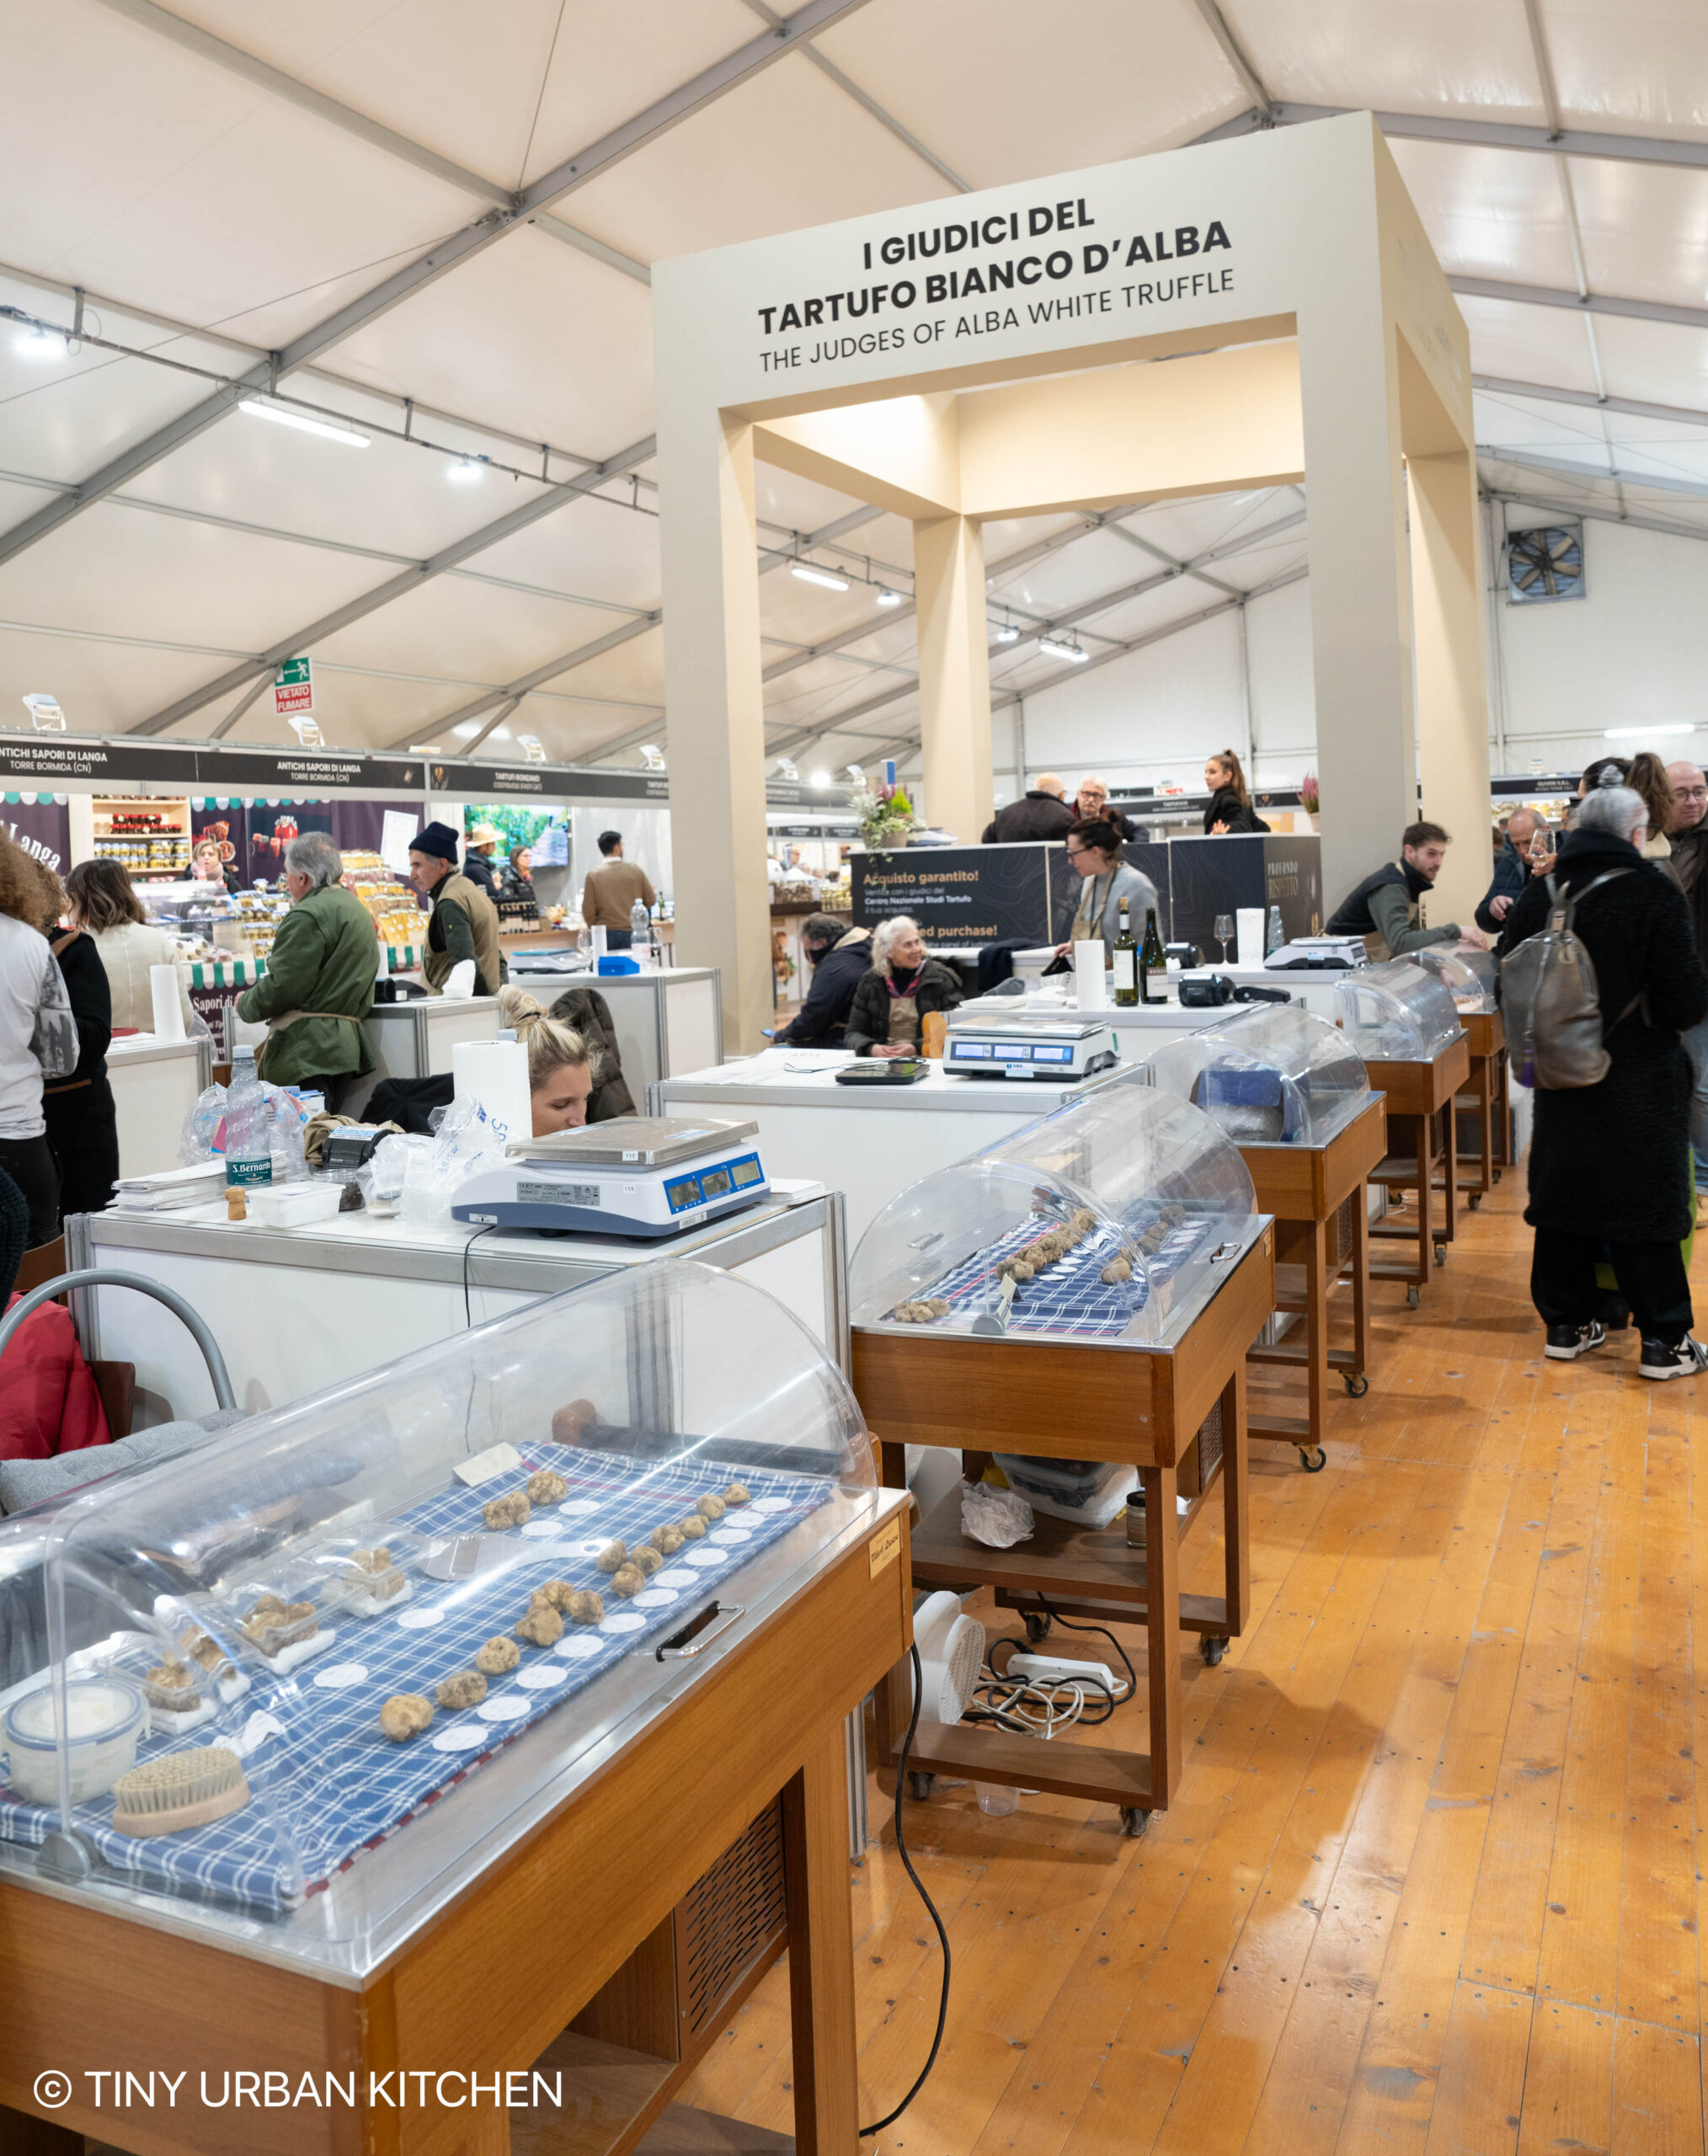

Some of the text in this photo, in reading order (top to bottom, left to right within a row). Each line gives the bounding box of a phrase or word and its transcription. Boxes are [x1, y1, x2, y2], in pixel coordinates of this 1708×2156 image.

[864, 199, 1094, 270] I GIUDICI DEL
[759, 281, 915, 334] TARTUFO
[926, 251, 1072, 303] BIANCO
[761, 269, 1233, 371] THE JUDGES OF ALBA WHITE TRUFFLE
[277, 686, 309, 700] VIETATO
[278, 697, 311, 712] FUMARE
[0, 747, 108, 762] NTICHI SAPORI DI LANGA
[10, 760, 92, 773] TORRE BORMIDA (CN)
[277, 761, 361, 773] ANTICHI SAPORI DI LANGA
[863, 870, 979, 887] Acquisto garantito!
[889, 896, 925, 905] Nazionale
[926, 895, 945, 904] Studi
[946, 894, 972, 903] Tartufo
[937, 925, 998, 938] purchase!
[193, 995, 232, 1014] Sapori di
[232, 1161, 271, 1173] S.Bernardo
